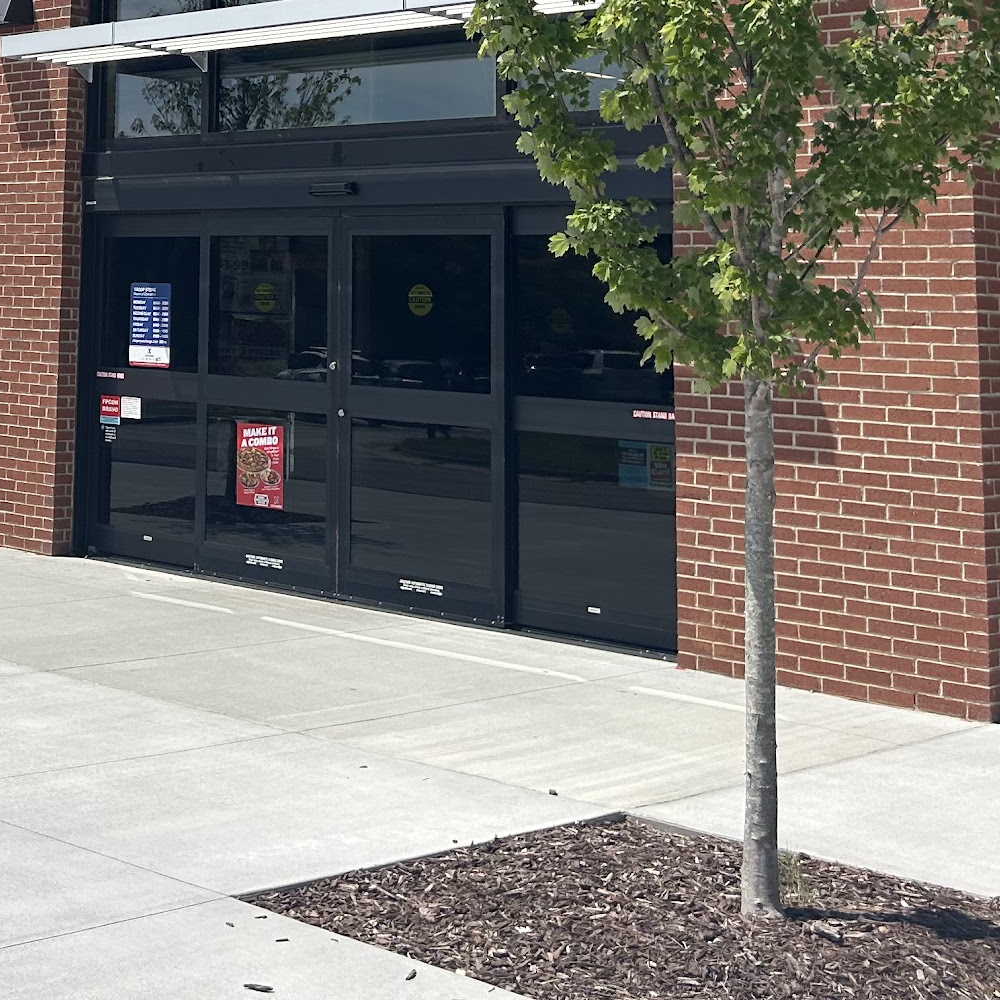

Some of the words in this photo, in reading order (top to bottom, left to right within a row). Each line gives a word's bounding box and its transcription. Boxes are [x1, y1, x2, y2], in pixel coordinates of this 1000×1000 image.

[243, 427, 267, 438] MAKE
[268, 426, 277, 435] IT
[241, 438, 248, 448] A
[248, 436, 278, 447] COMBO
